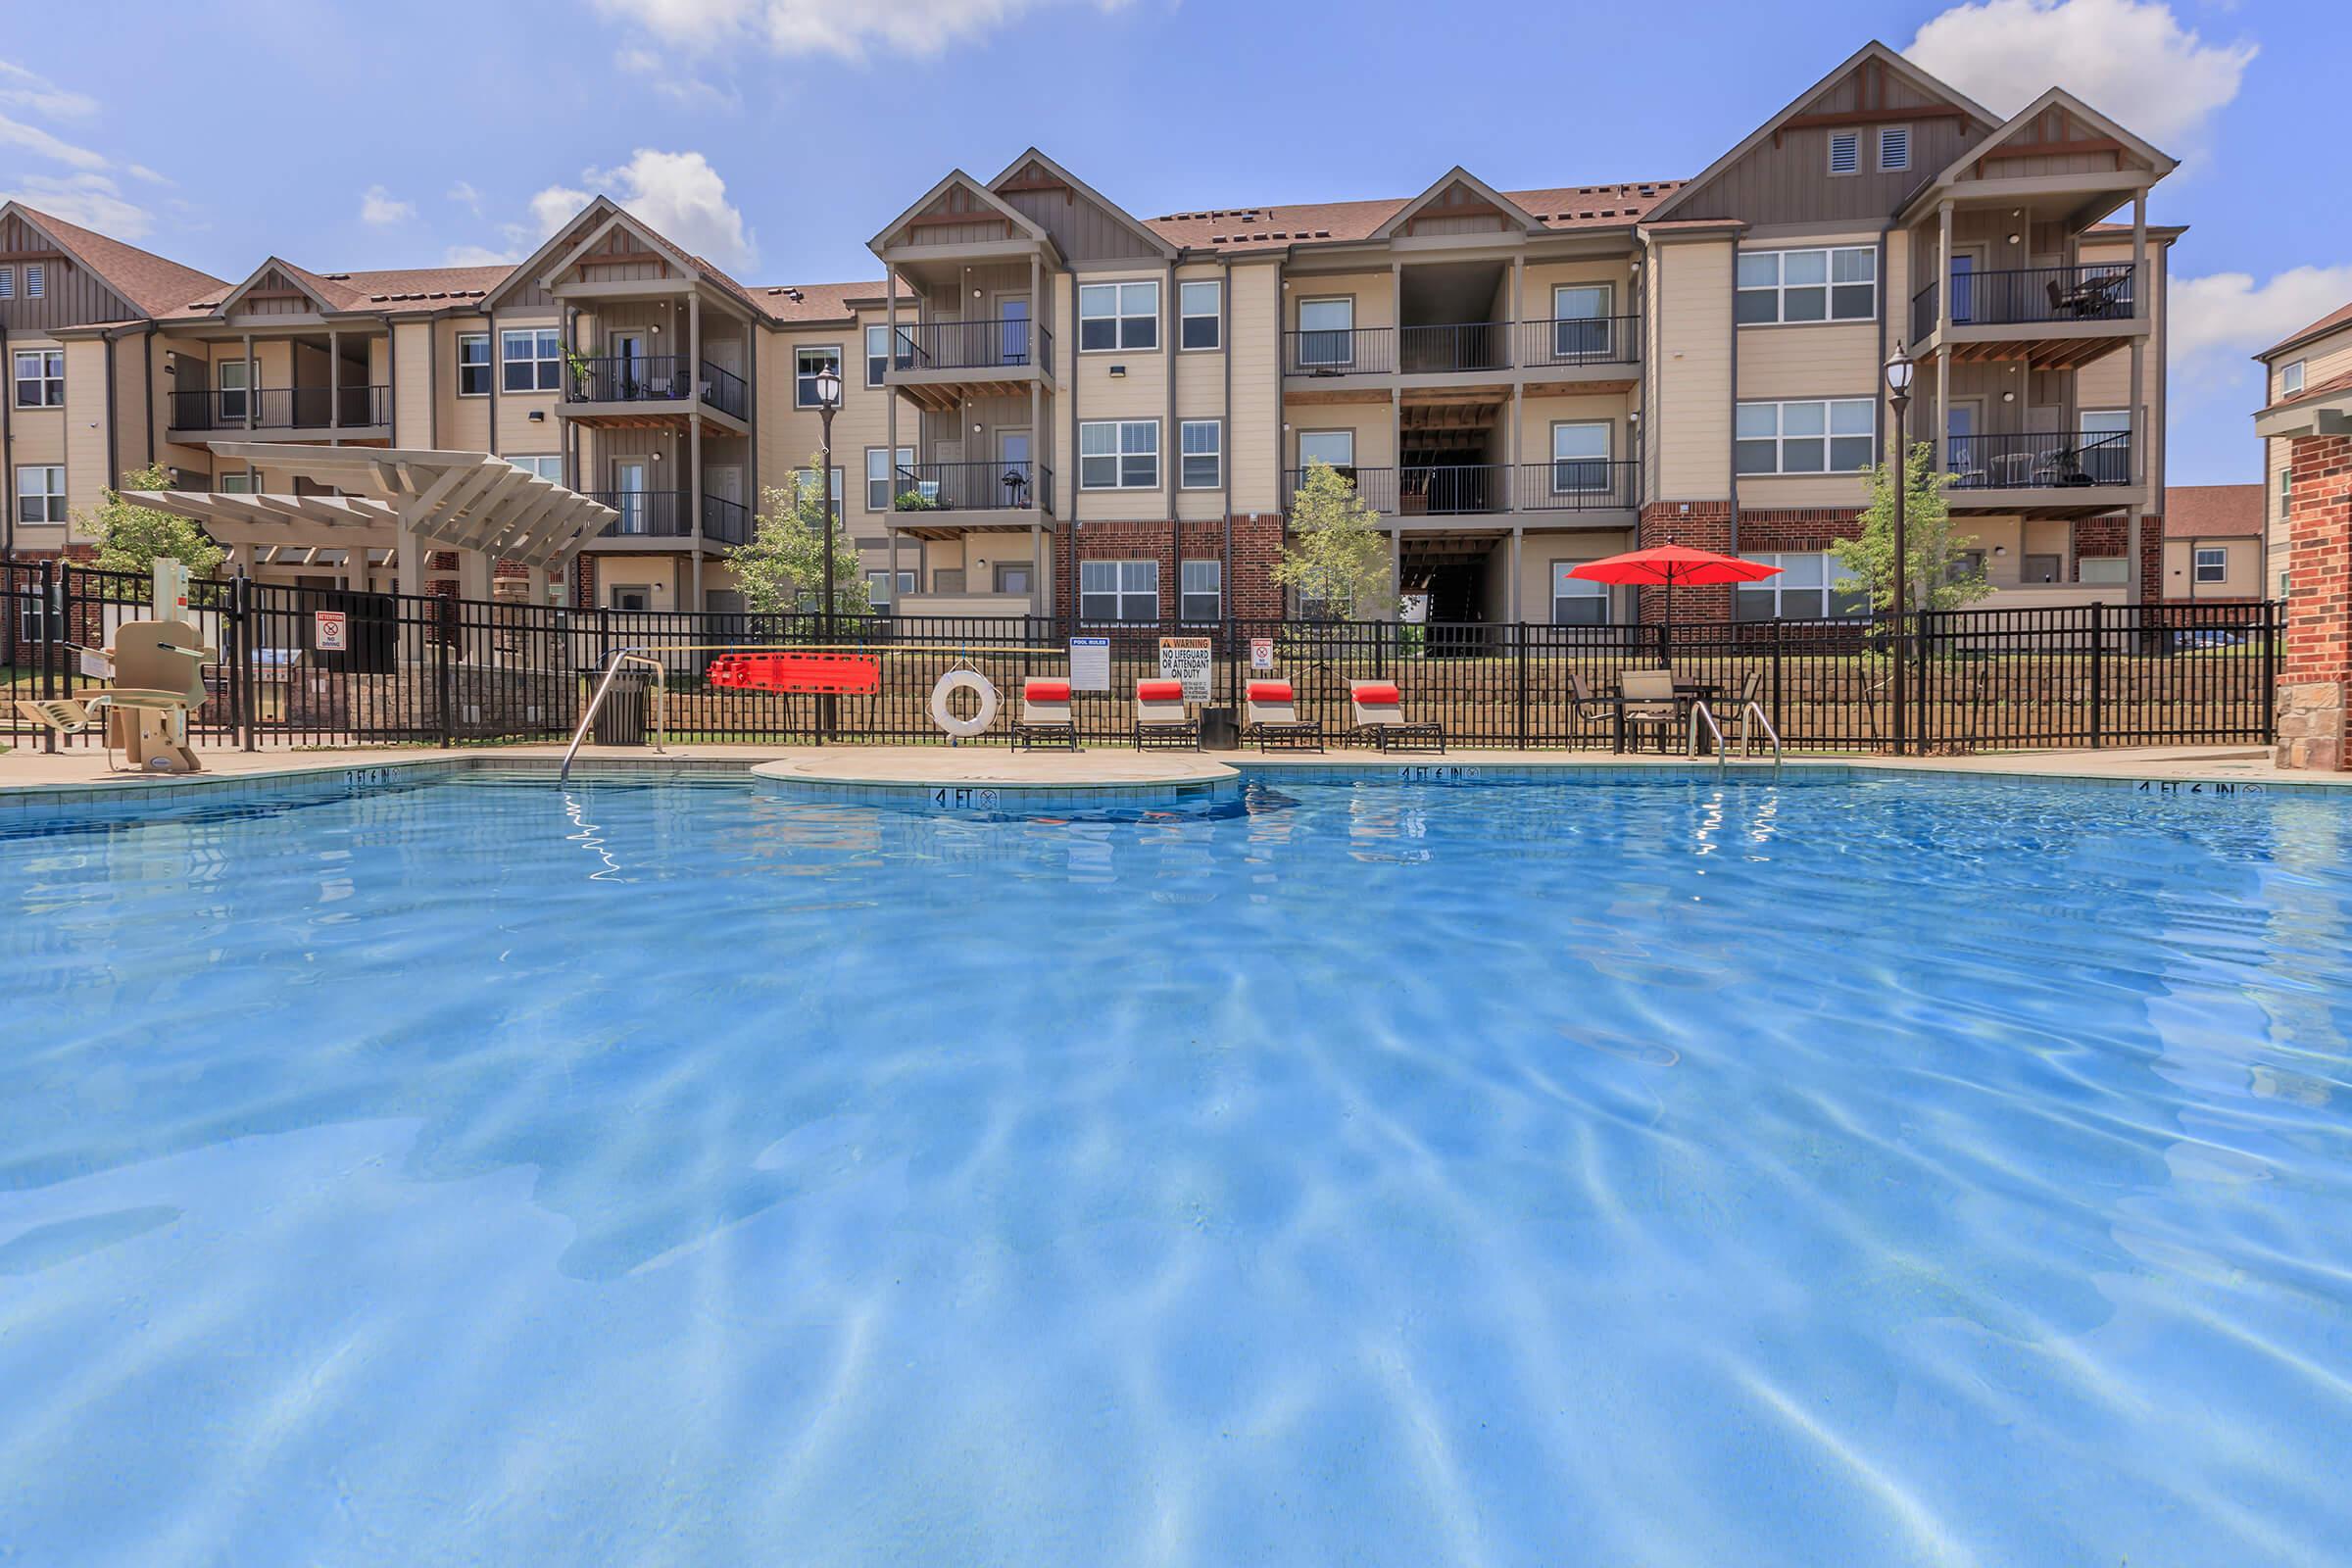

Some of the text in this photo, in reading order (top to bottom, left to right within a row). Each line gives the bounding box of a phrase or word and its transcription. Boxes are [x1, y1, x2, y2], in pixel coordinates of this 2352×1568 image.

[1174, 638, 1208, 648] WARNING
[1162, 650, 1208, 659] NO LIFEGUARD
[1162, 660, 1209, 668] OR ATTENDANT
[1171, 669, 1200, 678] ON DUTY
[935, 789, 972, 808] 4 FT
